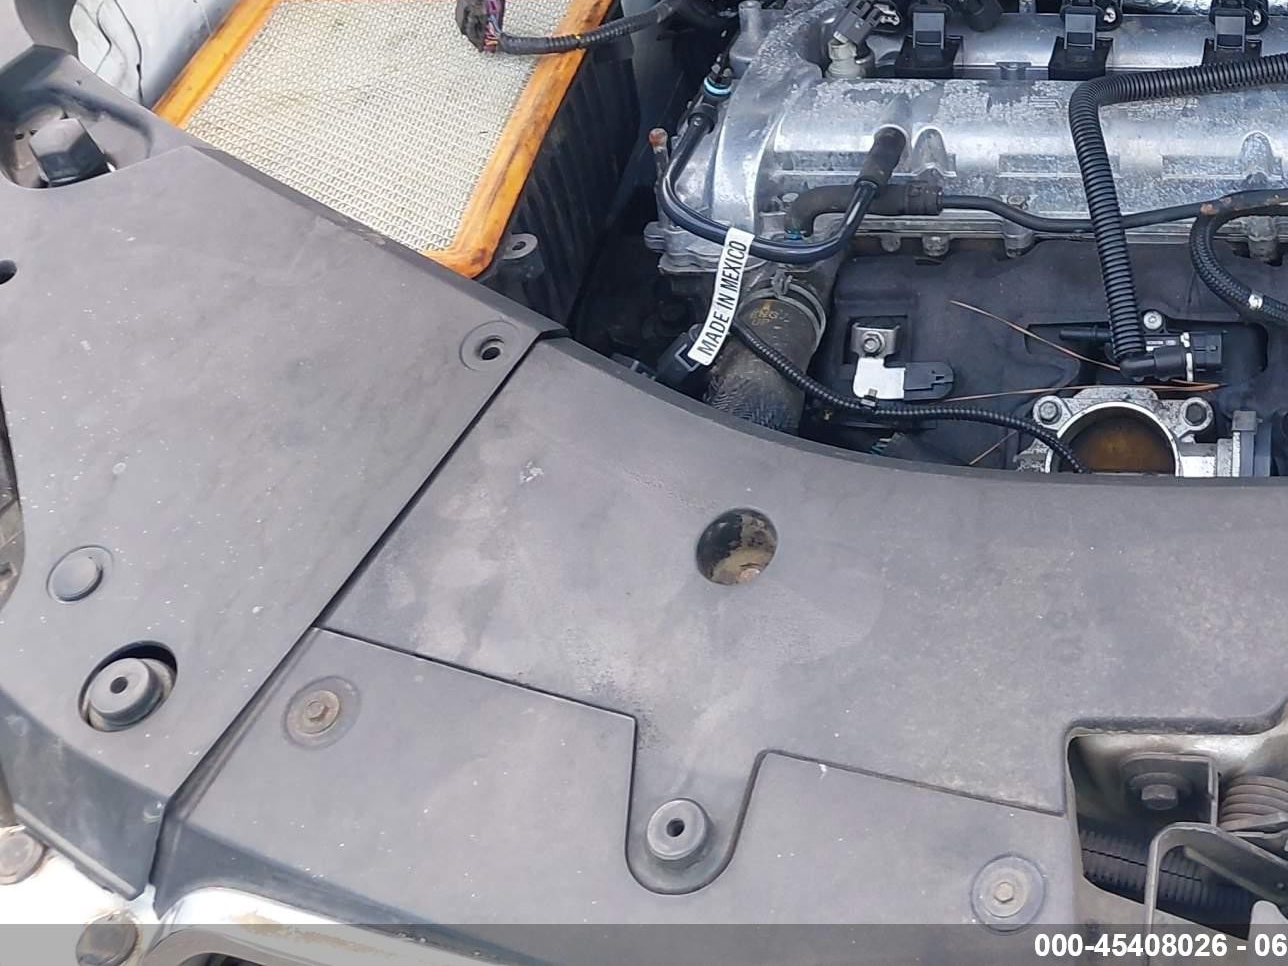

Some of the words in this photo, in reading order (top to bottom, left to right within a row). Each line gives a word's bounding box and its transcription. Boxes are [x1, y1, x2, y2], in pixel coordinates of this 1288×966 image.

[719, 240, 747, 293] MEXICO
[716, 292, 736, 311] IN
[696, 310, 730, 356] MADE
